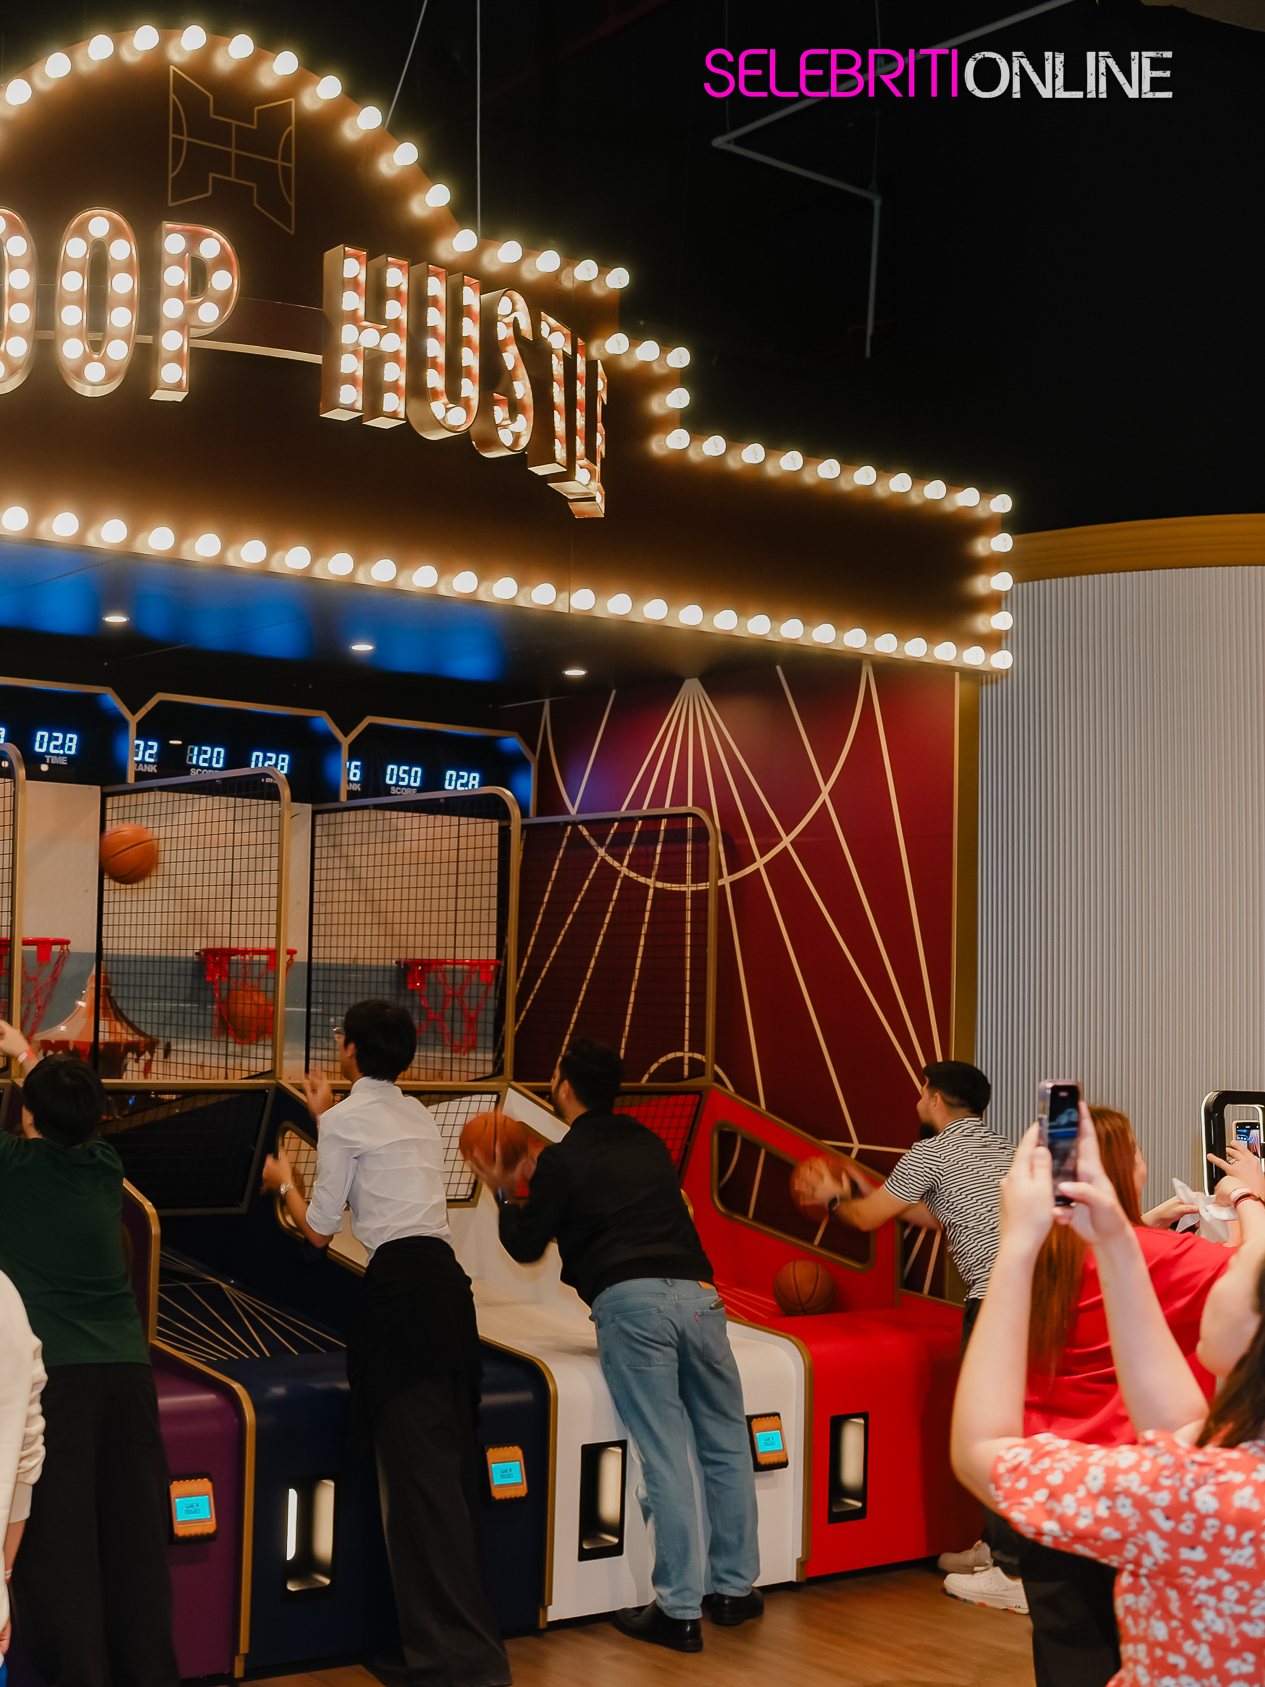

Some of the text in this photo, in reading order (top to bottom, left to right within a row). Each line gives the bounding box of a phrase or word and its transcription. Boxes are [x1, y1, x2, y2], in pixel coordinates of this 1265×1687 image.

[44, 755, 68, 766] TIME
[191, 746, 225, 768] 120
[385, 764, 423, 787] 050
